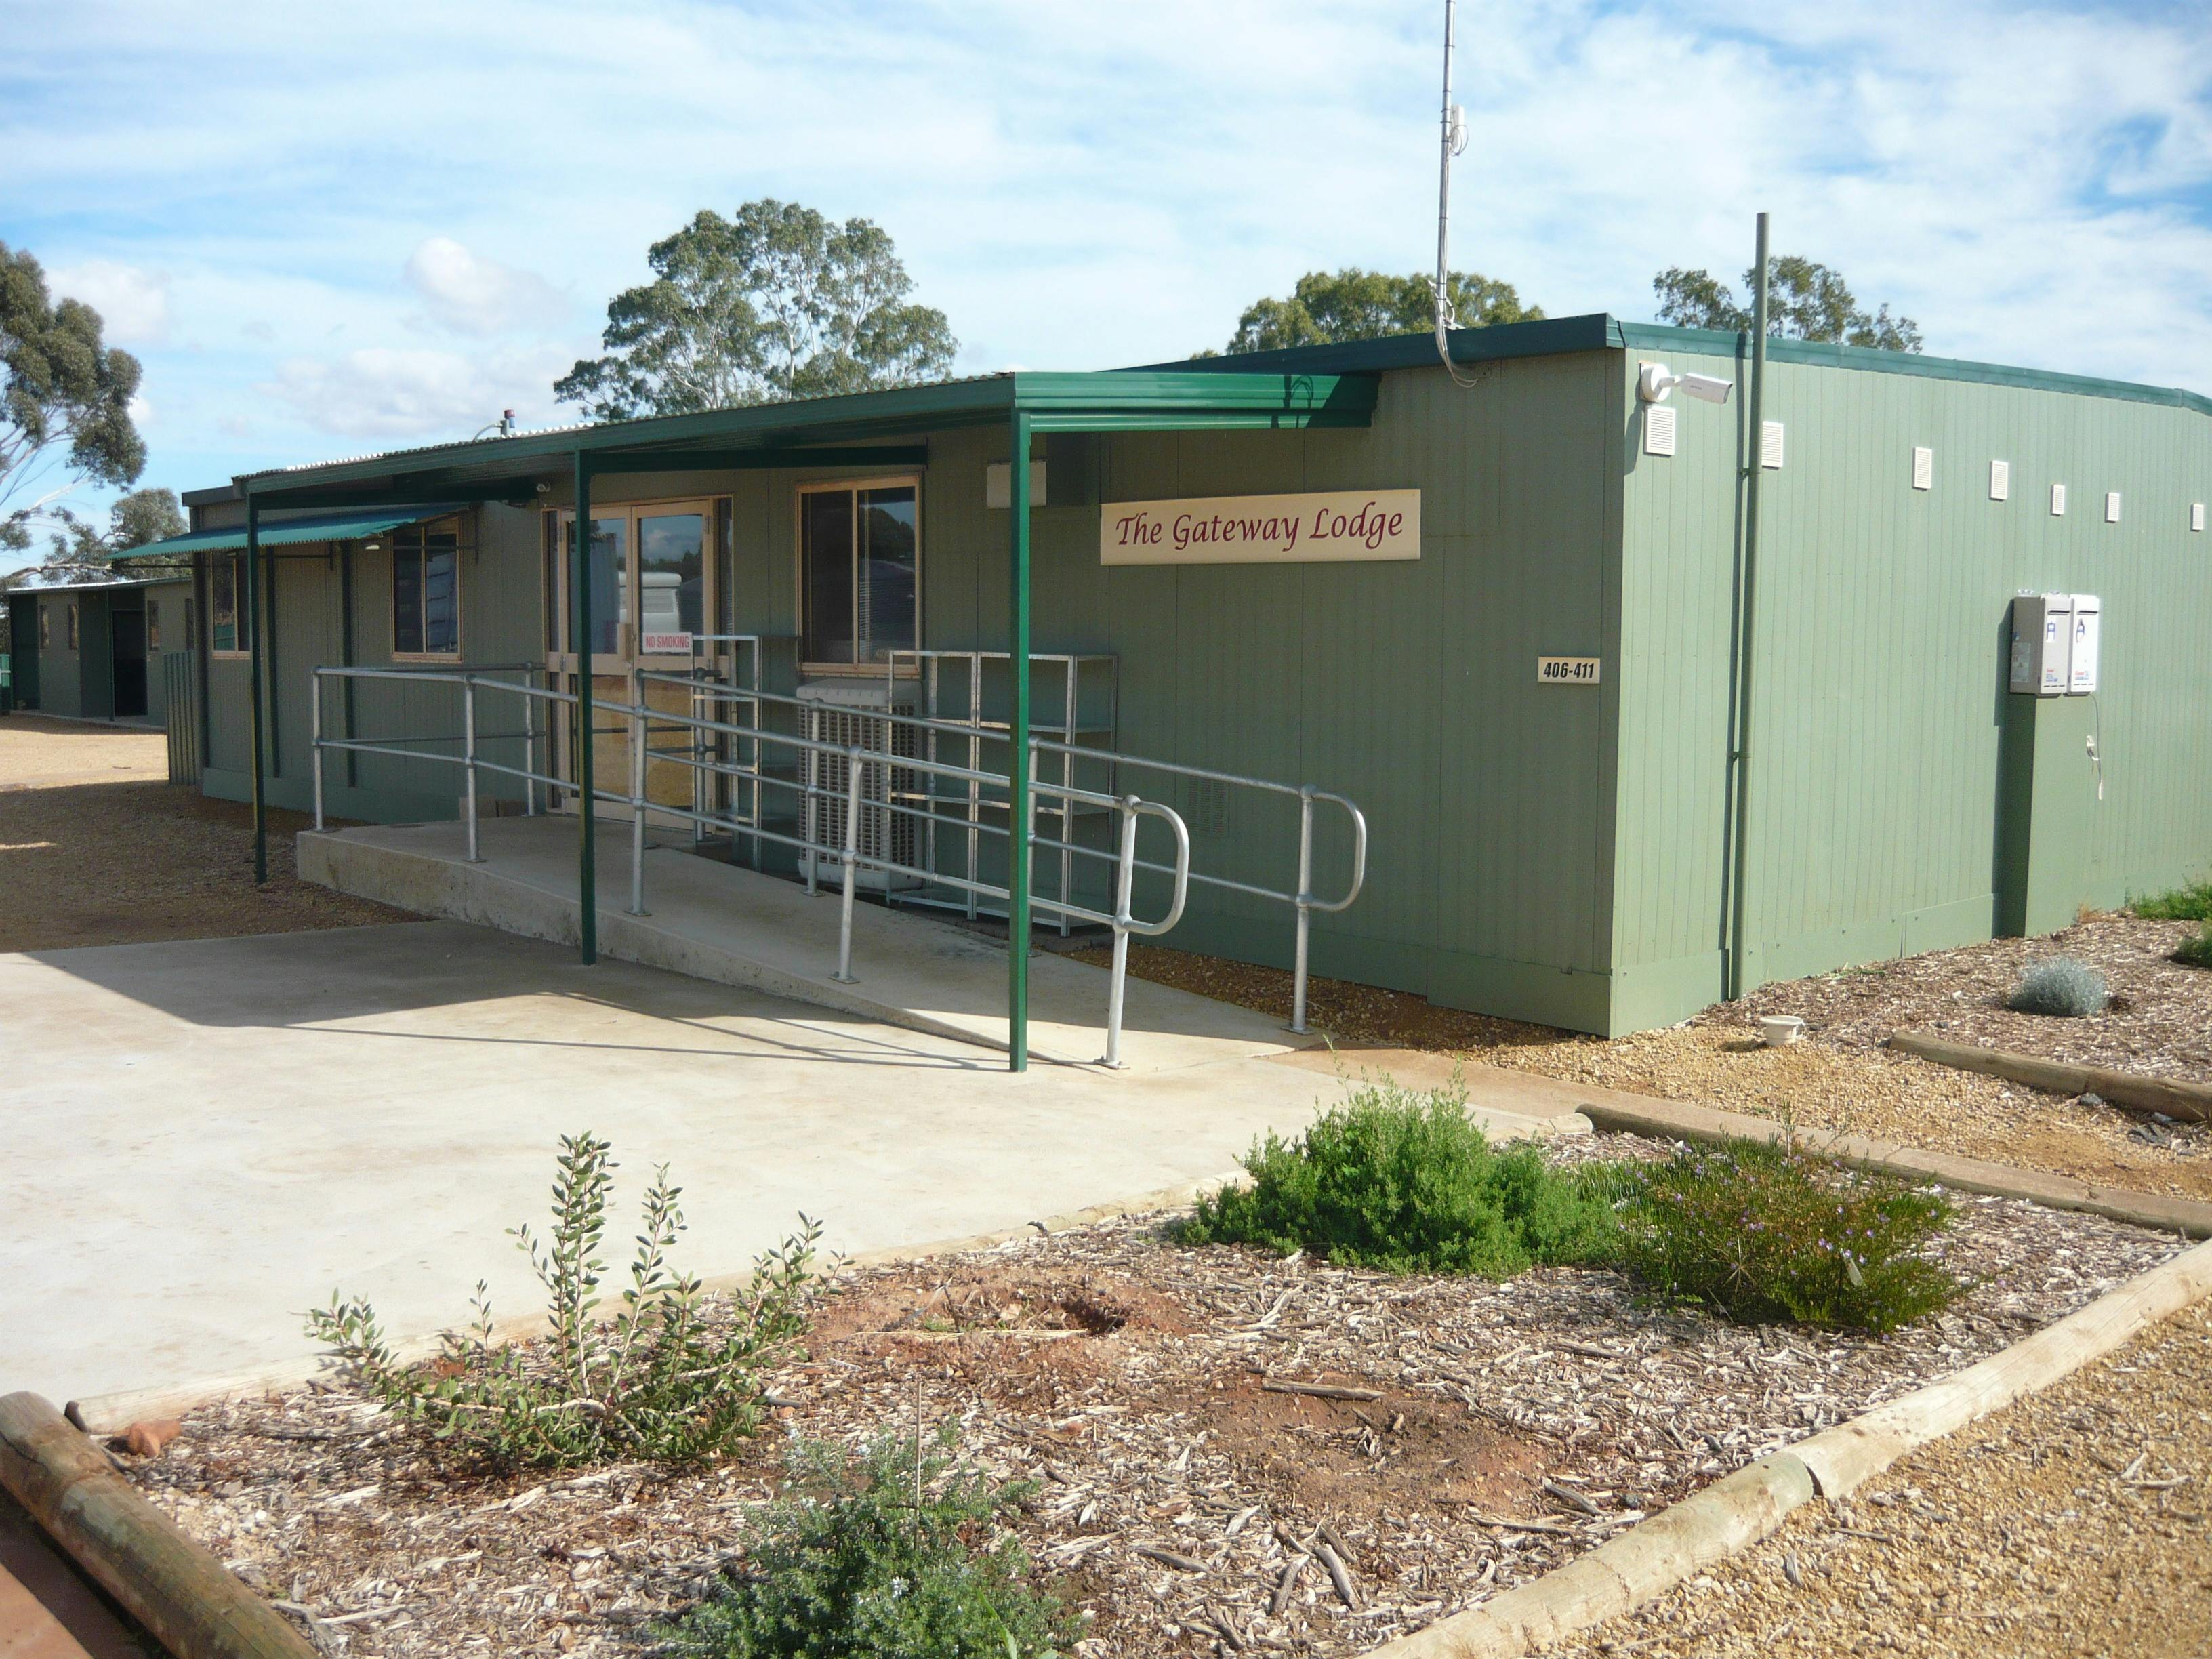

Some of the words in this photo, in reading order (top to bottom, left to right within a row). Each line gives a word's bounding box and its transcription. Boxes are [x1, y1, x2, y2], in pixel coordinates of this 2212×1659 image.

[1115, 512, 1162, 545] The
[1172, 514, 1300, 552] Gateway
[1309, 501, 1403, 550] Lodge
[645, 636, 655, 648] NO
[657, 636, 689, 648] SMOKING
[1543, 662, 1594, 678] 406-411
